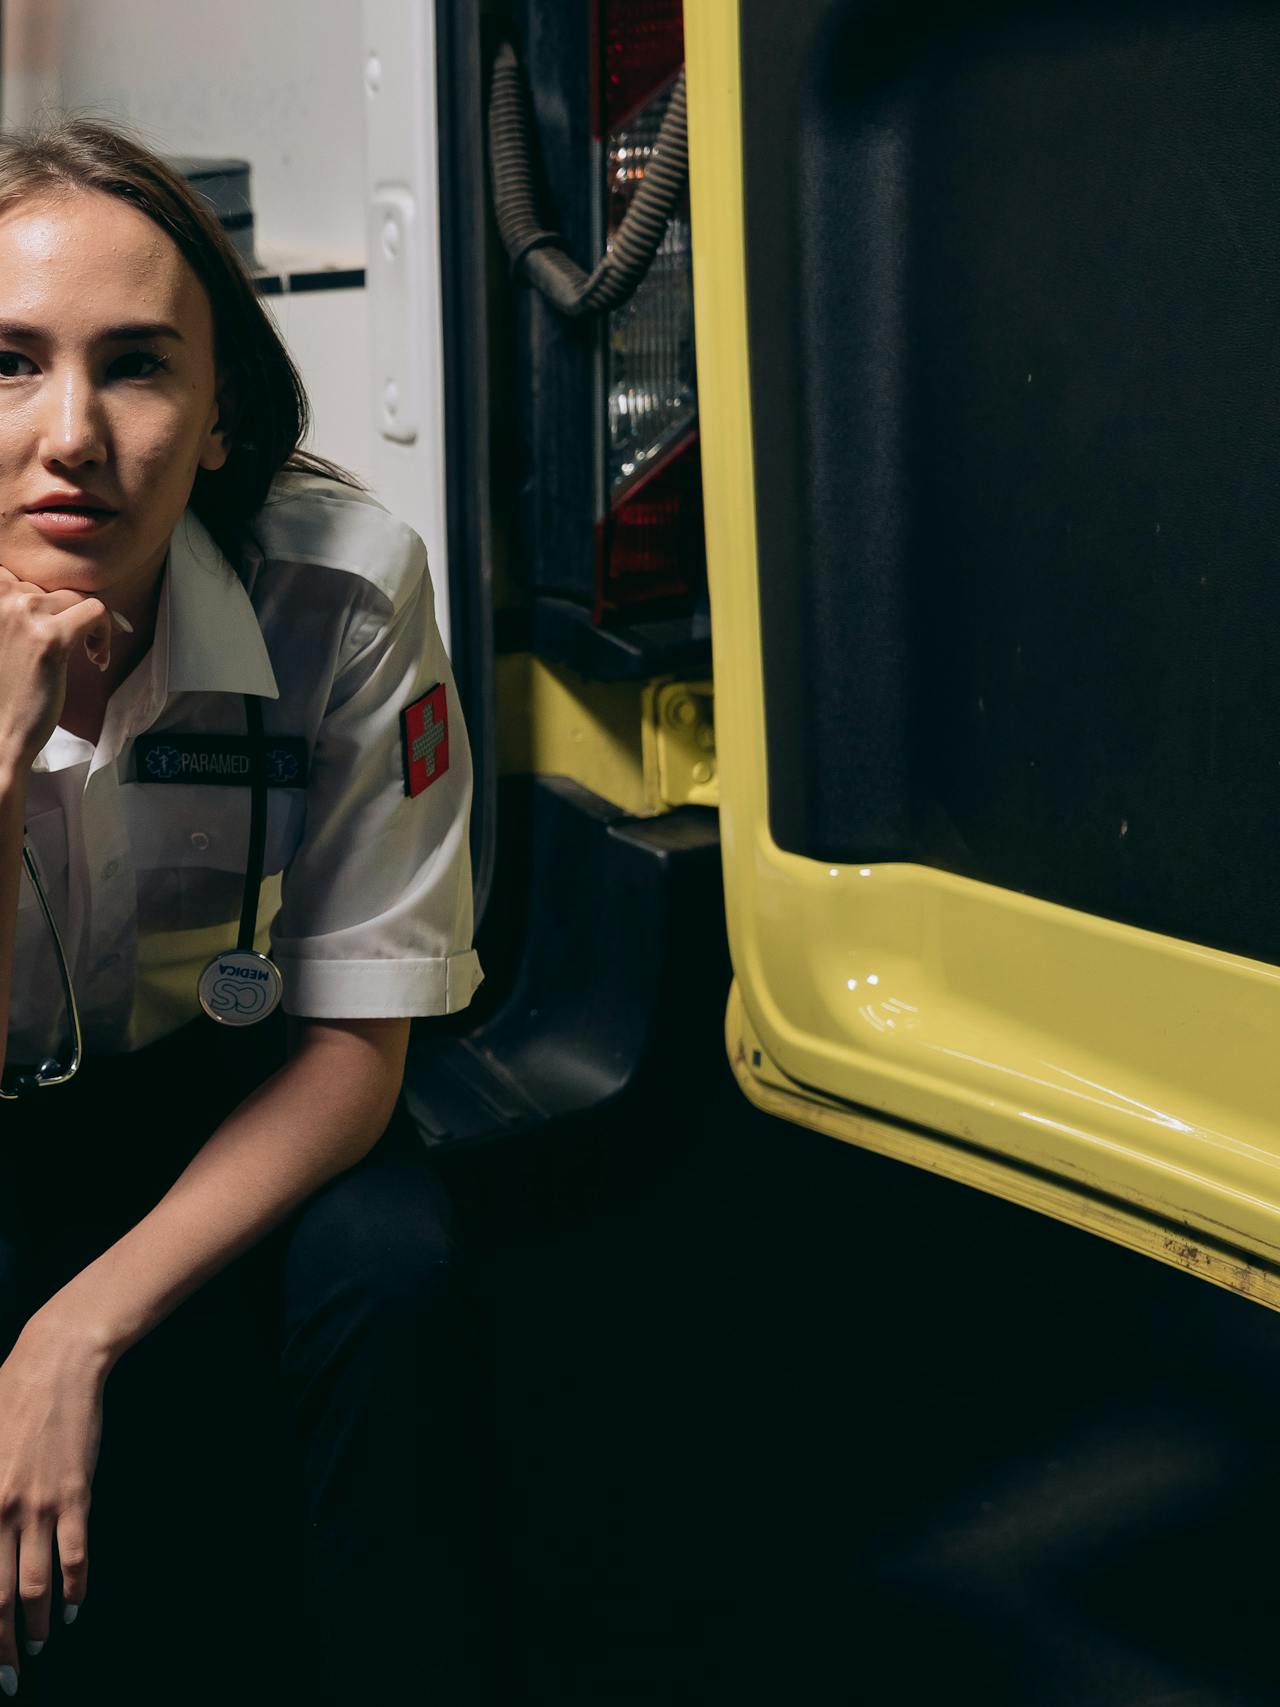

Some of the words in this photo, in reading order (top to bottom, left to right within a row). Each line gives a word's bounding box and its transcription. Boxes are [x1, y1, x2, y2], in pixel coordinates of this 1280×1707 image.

[181, 752, 251, 774] PARAMED
[218, 964, 269, 981] MEDICA
[210, 978, 266, 1014] CS
